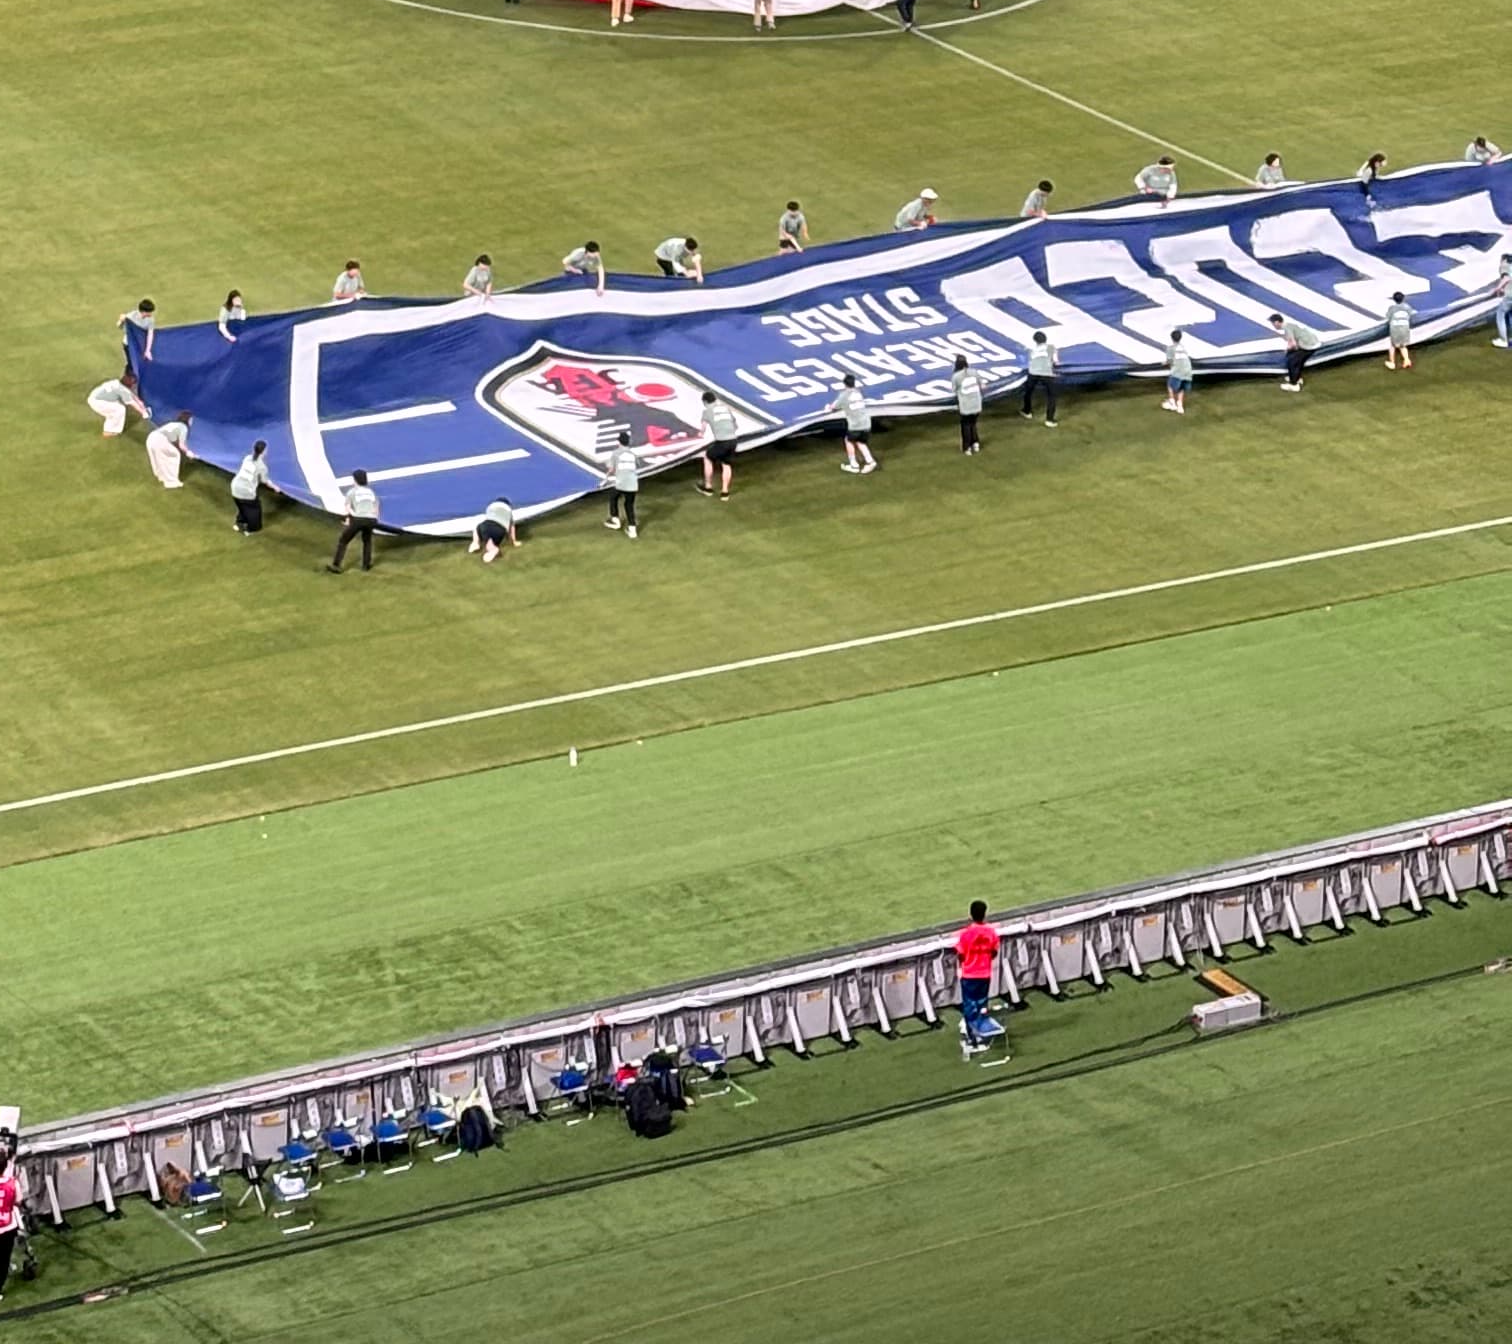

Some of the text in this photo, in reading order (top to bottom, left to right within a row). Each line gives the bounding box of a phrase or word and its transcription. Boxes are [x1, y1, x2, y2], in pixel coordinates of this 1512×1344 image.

[760, 286, 949, 348] STAGE
[940, 208, 1432, 365] 2026
[735, 330, 1017, 402] GREATEST
